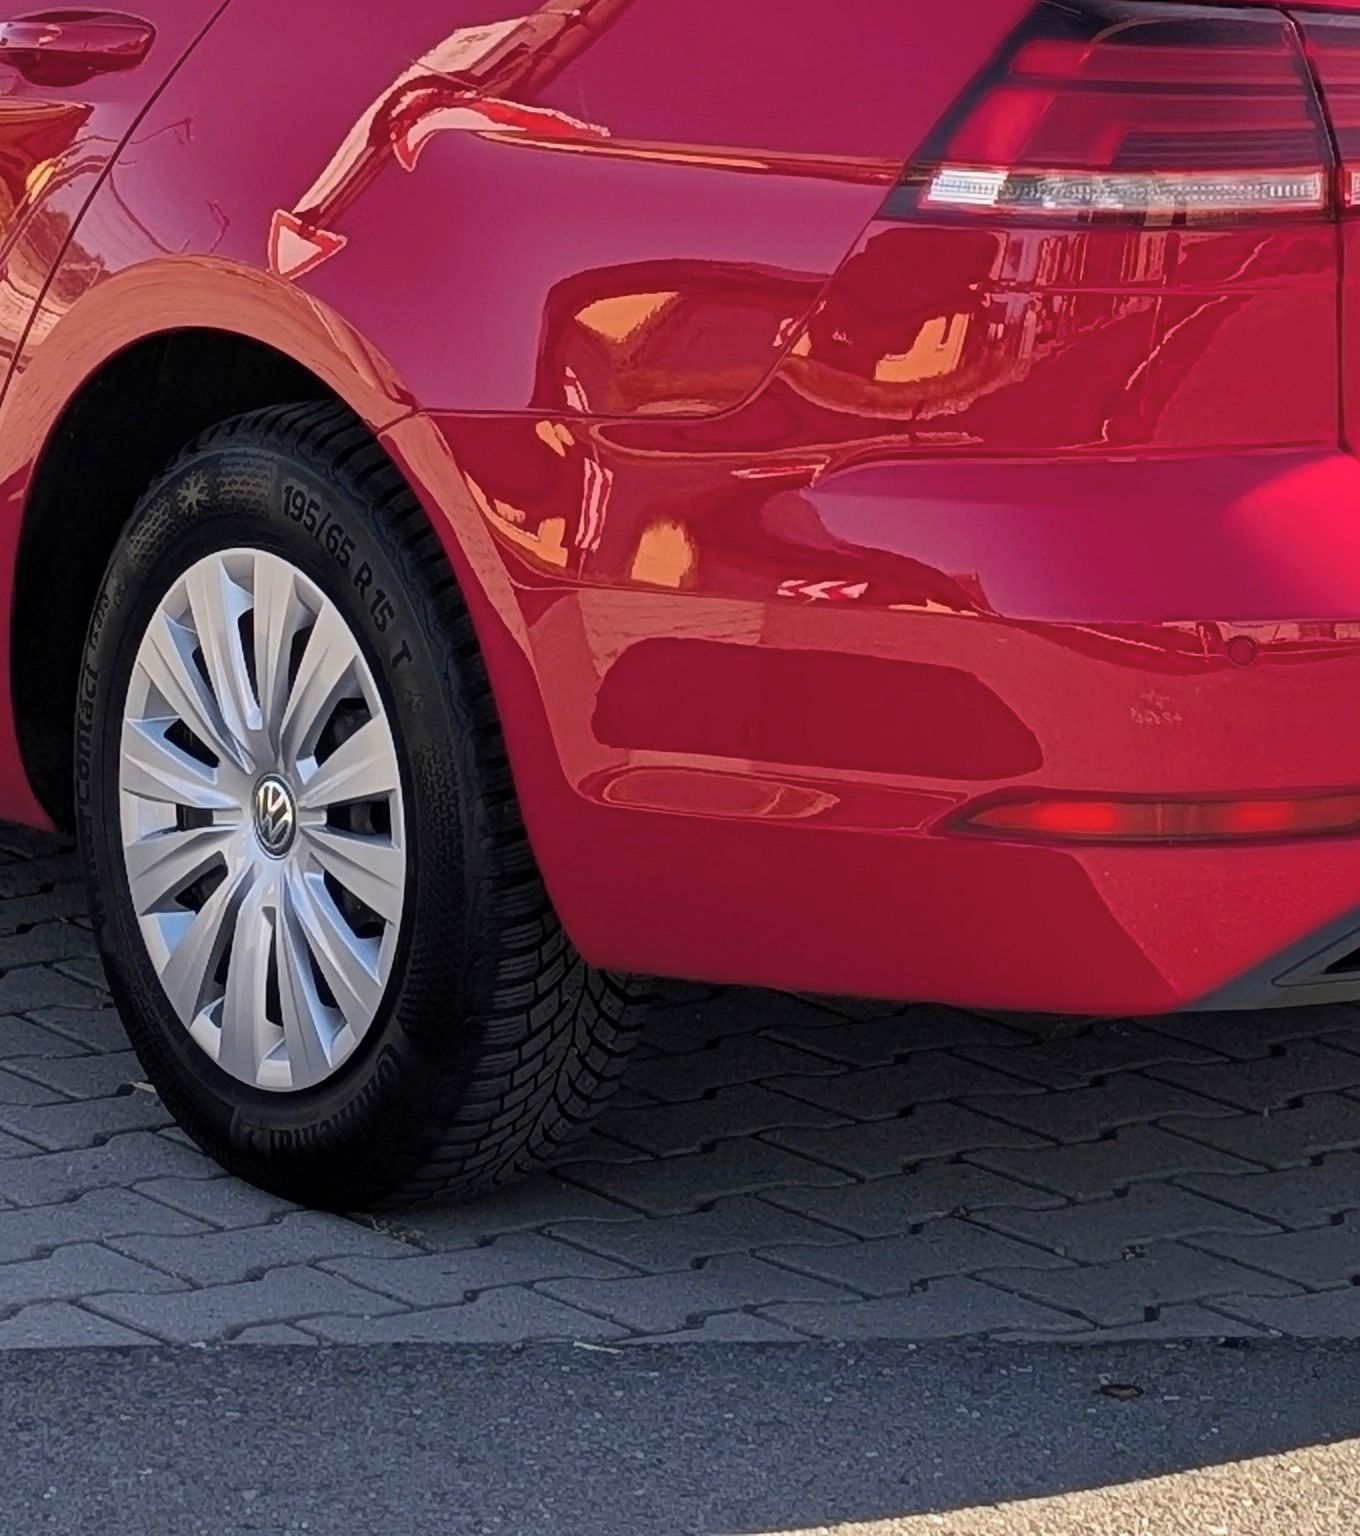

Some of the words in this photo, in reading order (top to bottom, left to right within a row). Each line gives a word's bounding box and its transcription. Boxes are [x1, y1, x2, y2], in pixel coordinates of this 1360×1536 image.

[283, 484, 357, 568] 195/65
[353, 560, 374, 601] R
[369, 588, 395, 633] 15
